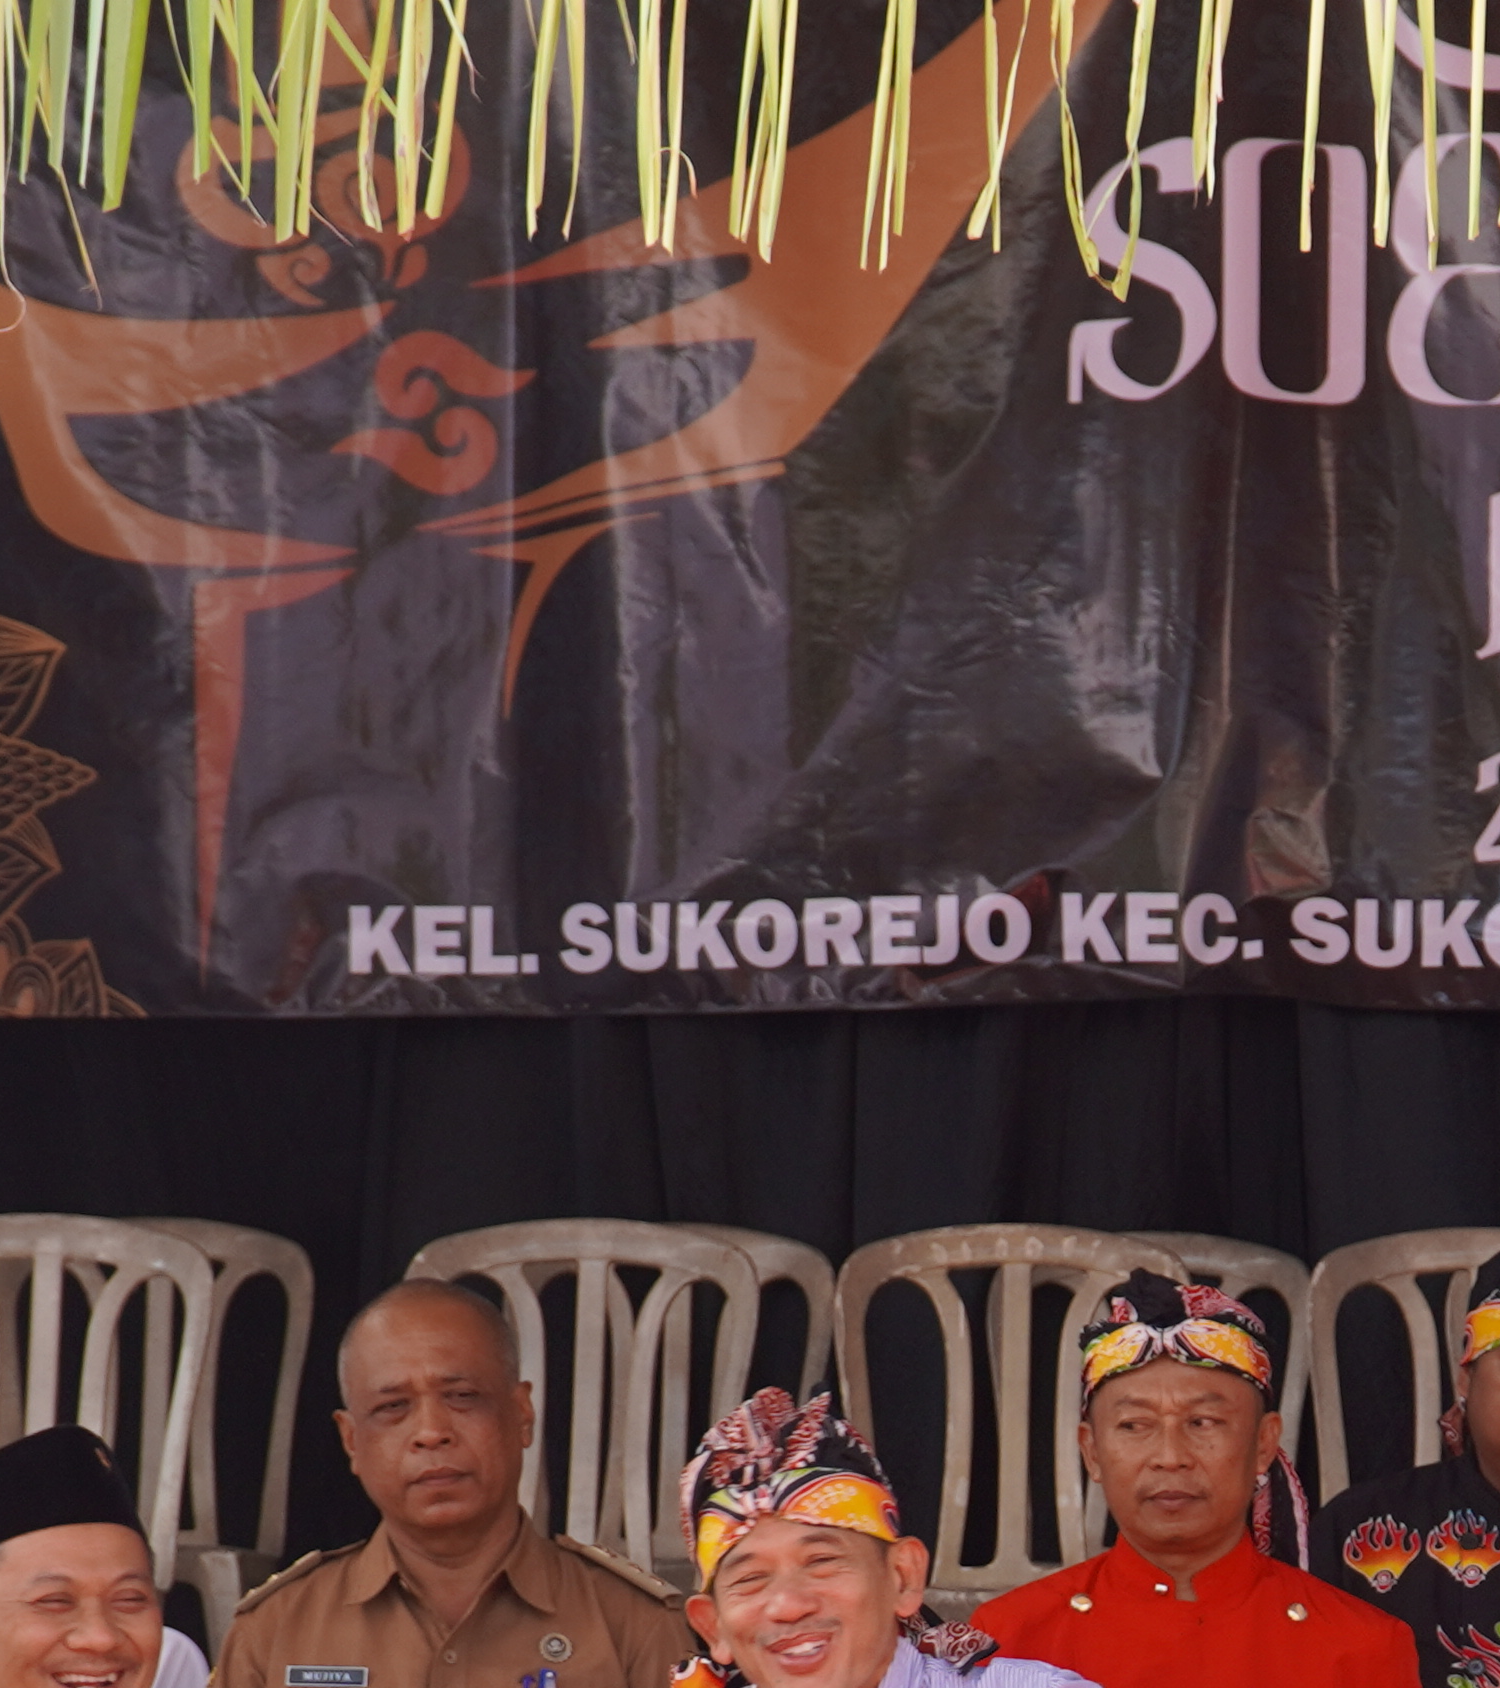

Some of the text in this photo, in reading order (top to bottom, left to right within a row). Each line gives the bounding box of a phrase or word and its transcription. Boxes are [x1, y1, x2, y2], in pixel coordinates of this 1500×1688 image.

[348, 904, 539, 975] KEL.
[560, 893, 1033, 974] SUKOREJO
[1061, 891, 1263, 964] KEC.
